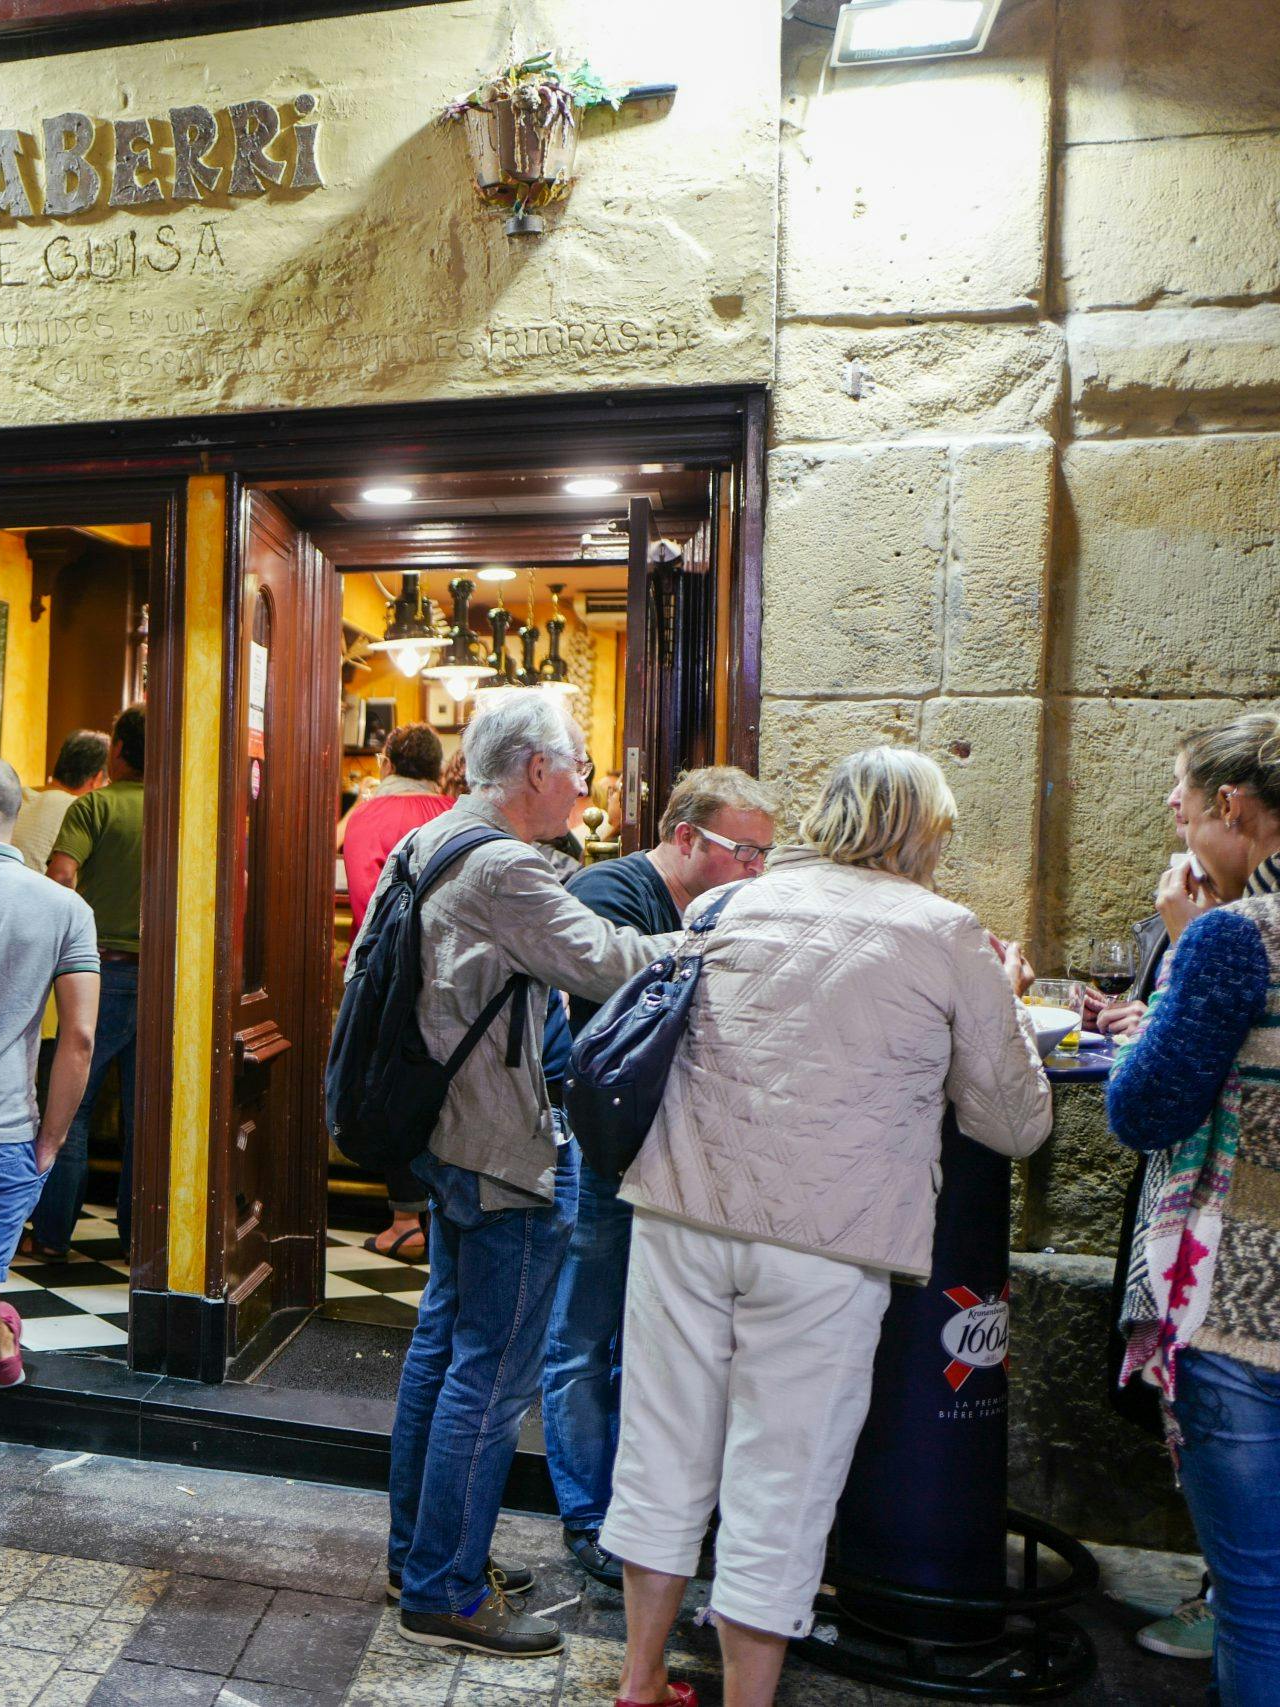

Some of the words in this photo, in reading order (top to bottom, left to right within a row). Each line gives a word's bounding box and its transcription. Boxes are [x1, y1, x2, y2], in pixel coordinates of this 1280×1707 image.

[0, 312, 114, 349] UNIDOS
[129, 308, 154, 326] EN
[166, 307, 209, 334] UNA
[489, 321, 640, 359] FRITURAS
[957, 1315, 1008, 1354] 1664
[955, 1400, 969, 1409] LA
